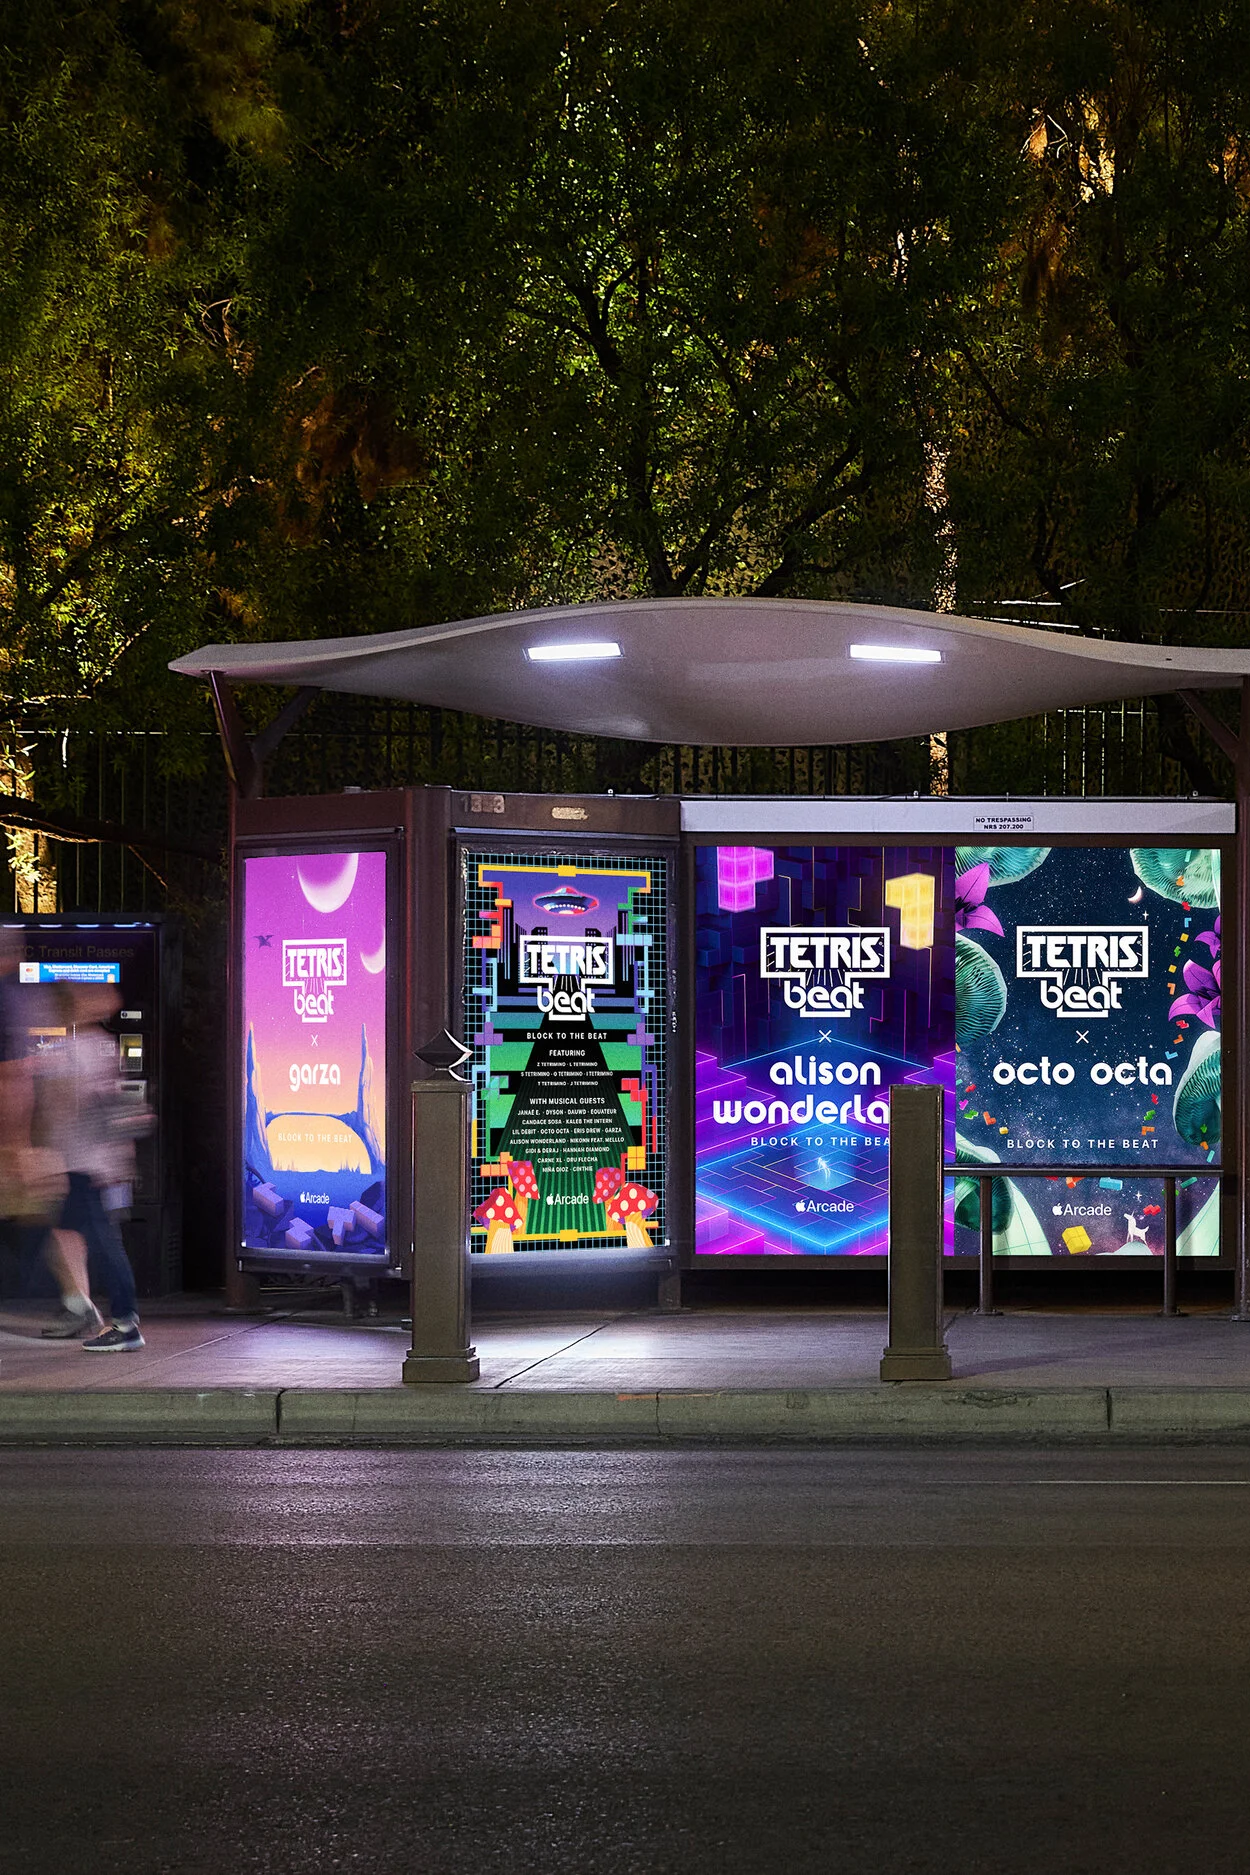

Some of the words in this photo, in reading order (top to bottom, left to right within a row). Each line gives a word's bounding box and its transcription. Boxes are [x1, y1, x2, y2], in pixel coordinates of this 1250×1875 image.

[40, 946, 82, 958] Transit
[87, 946, 134, 958] Passes
[288, 948, 342, 978] TETRIS
[527, 944, 606, 976] TETRIS
[770, 937, 880, 968] TETRIS
[1026, 936, 1138, 968] TETRIS
[294, 989, 334, 1015] beat
[537, 986, 595, 1013] beat
[784, 980, 864, 1009] beat
[1040, 980, 1122, 1009] beat
[289, 1064, 340, 1092] garza
[770, 1056, 881, 1085] alison
[993, 1056, 1075, 1085] octo
[1091, 1056, 1172, 1085] octa
[713, 1095, 889, 1124] wonderla
[278, 1133, 302, 1142] BLOCK
[305, 1134, 314, 1142] TO
[318, 1134, 331, 1143] THE
[334, 1134, 353, 1143] BEAT
[751, 1137, 799, 1146] BLOCK
[806, 1137, 823, 1146] TO
[831, 1137, 857, 1146] THE
[865, 1137, 890, 1146] BEA
[1007, 1139, 1055, 1148] BLOCK
[1063, 1139, 1080, 1148] TO
[1088, 1139, 1115, 1148] THE
[1123, 1139, 1159, 1148] BEAT
[306, 1192, 330, 1204] Arcade
[554, 1193, 589, 1205] Arcade
[806, 1200, 854, 1212] Arcade
[1063, 1203, 1112, 1216] Arcade
